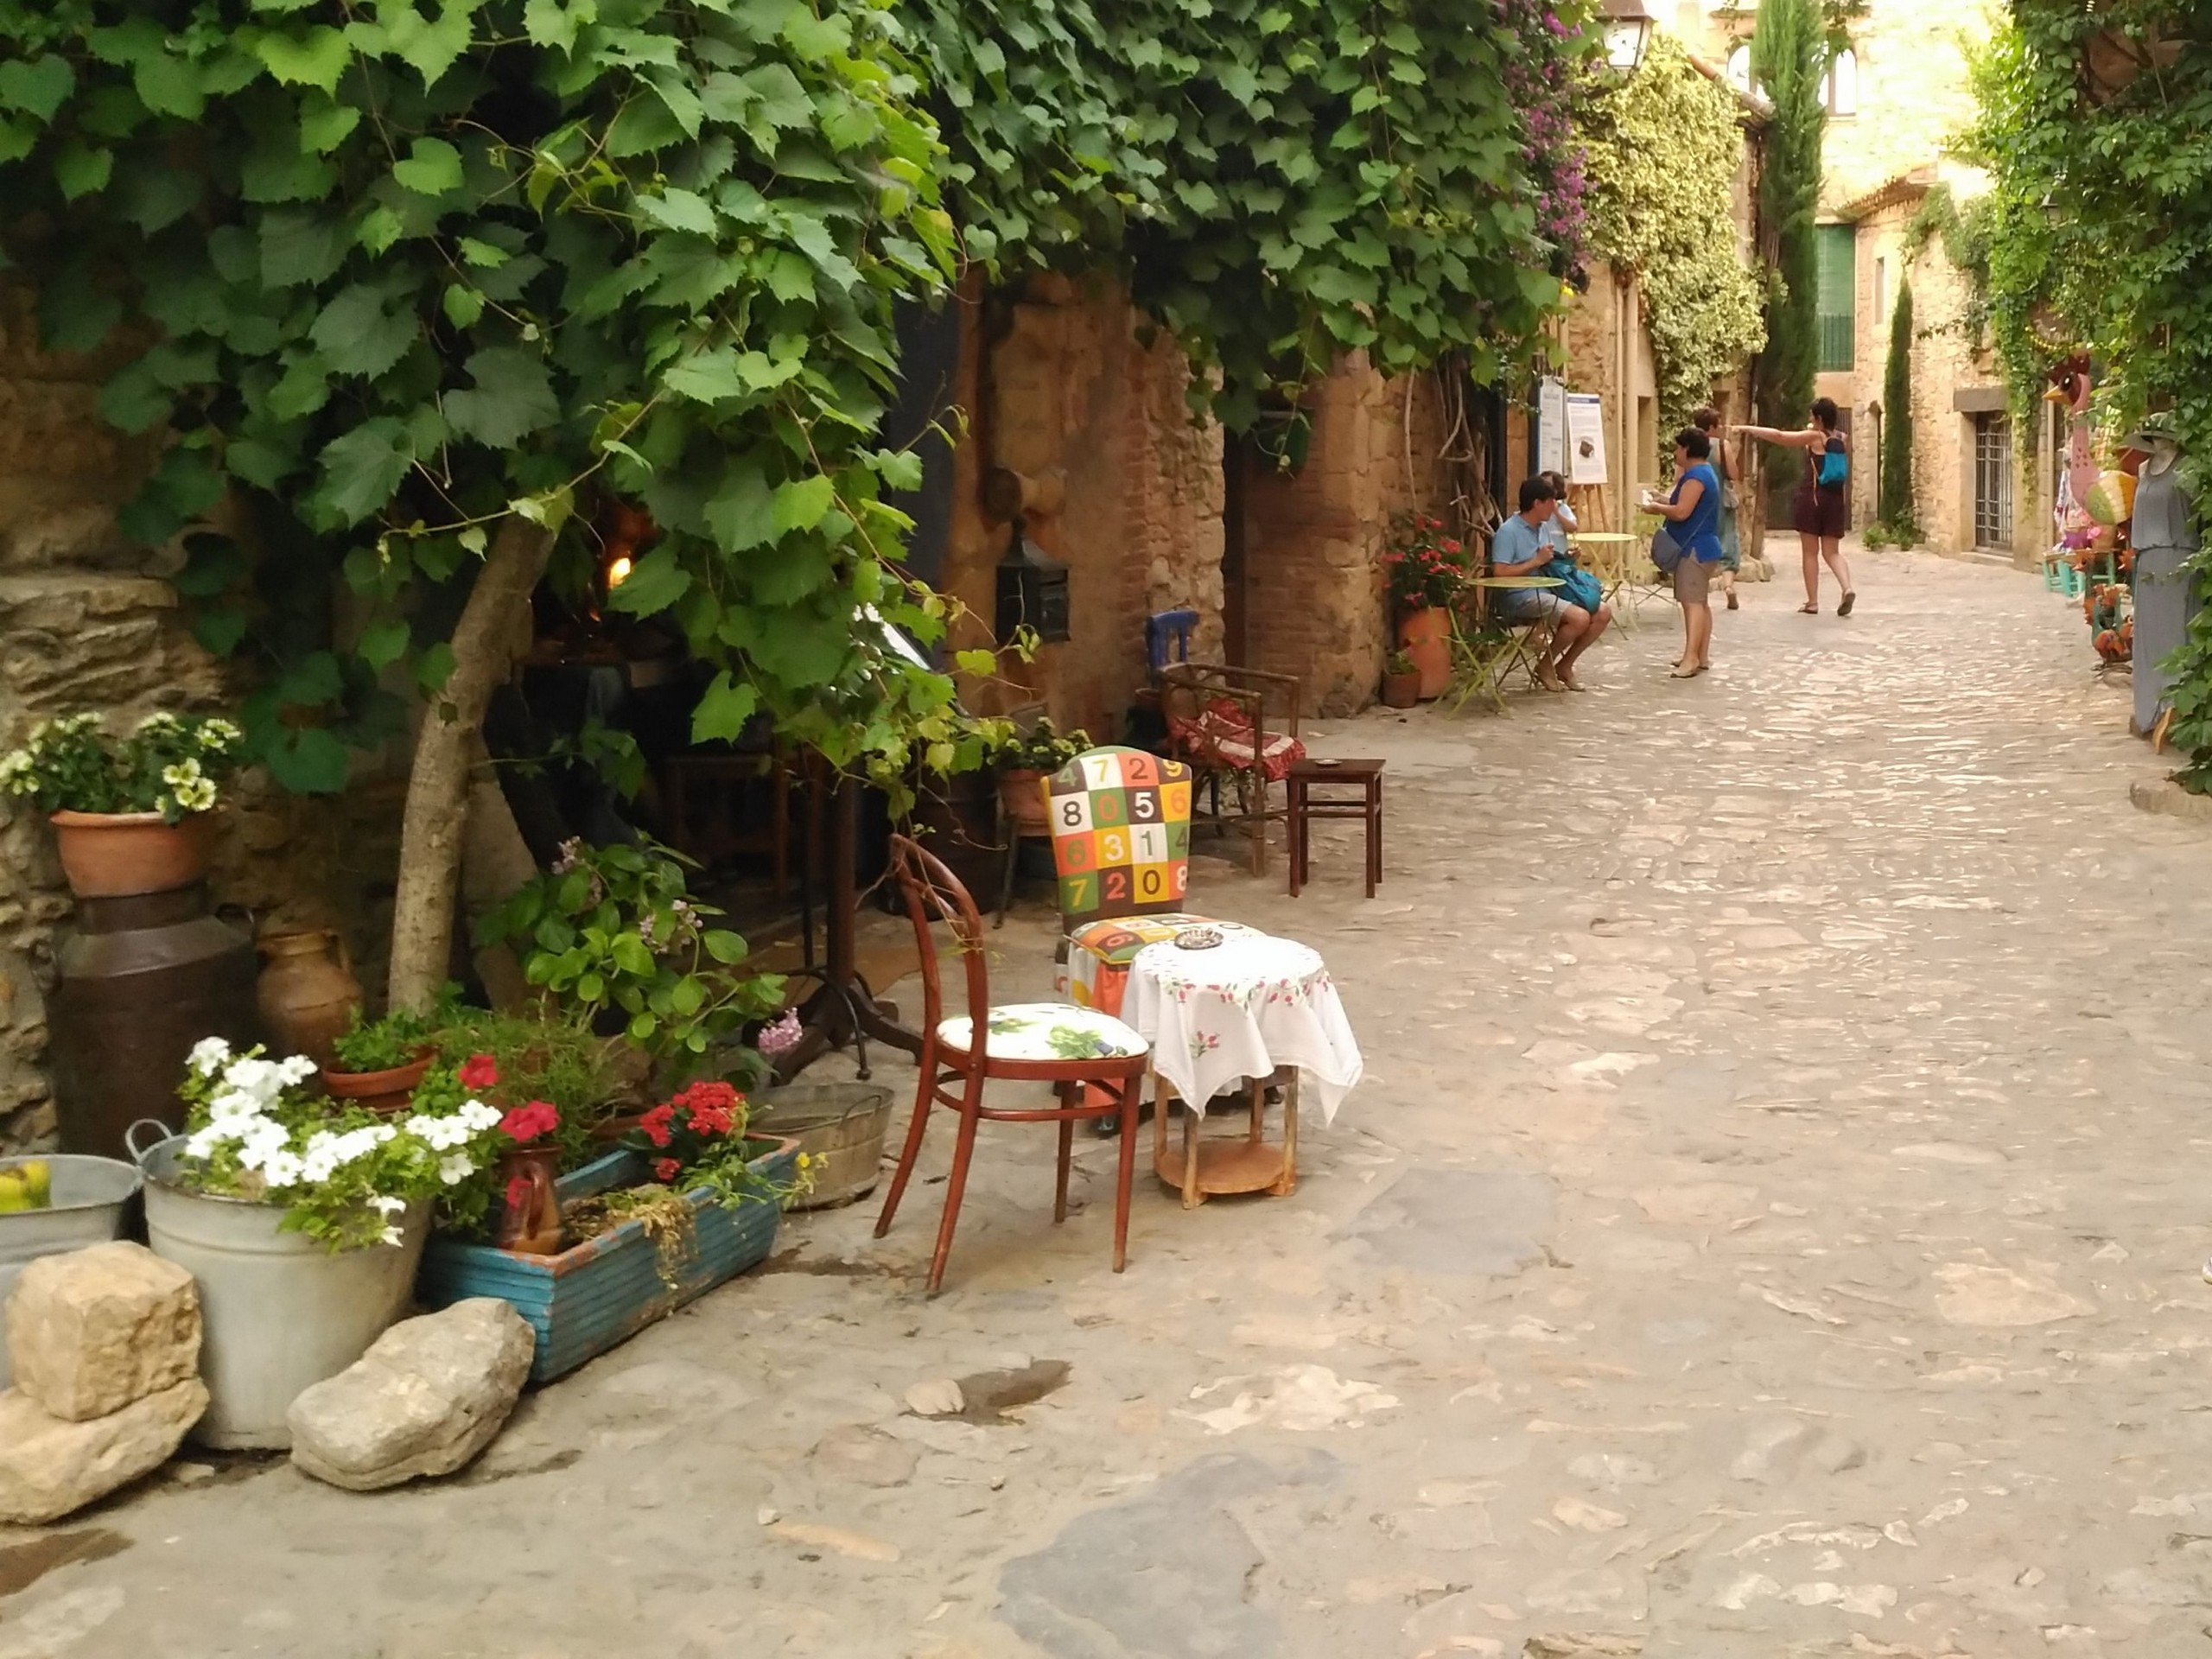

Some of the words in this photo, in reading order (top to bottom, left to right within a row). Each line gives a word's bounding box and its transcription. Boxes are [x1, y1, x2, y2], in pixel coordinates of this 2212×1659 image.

[1058, 766, 1077, 786] 4
[1092, 760, 1109, 782] 7
[1128, 758, 1148, 779] 2
[1162, 759, 1183, 778] 9
[1063, 800, 1083, 827] 8
[1098, 793, 1118, 822] 0
[1135, 791, 1154, 818] 5
[1171, 788, 1189, 814] 6
[1066, 839, 1086, 867] 6
[1104, 834, 1124, 861] 3
[1141, 830, 1153, 856] 1
[1175, 825, 1189, 852] 4
[1069, 879, 1088, 906] 7
[1107, 872, 1126, 899] 2
[1142, 869, 1160, 895] 0
[1177, 865, 1188, 892] 8
